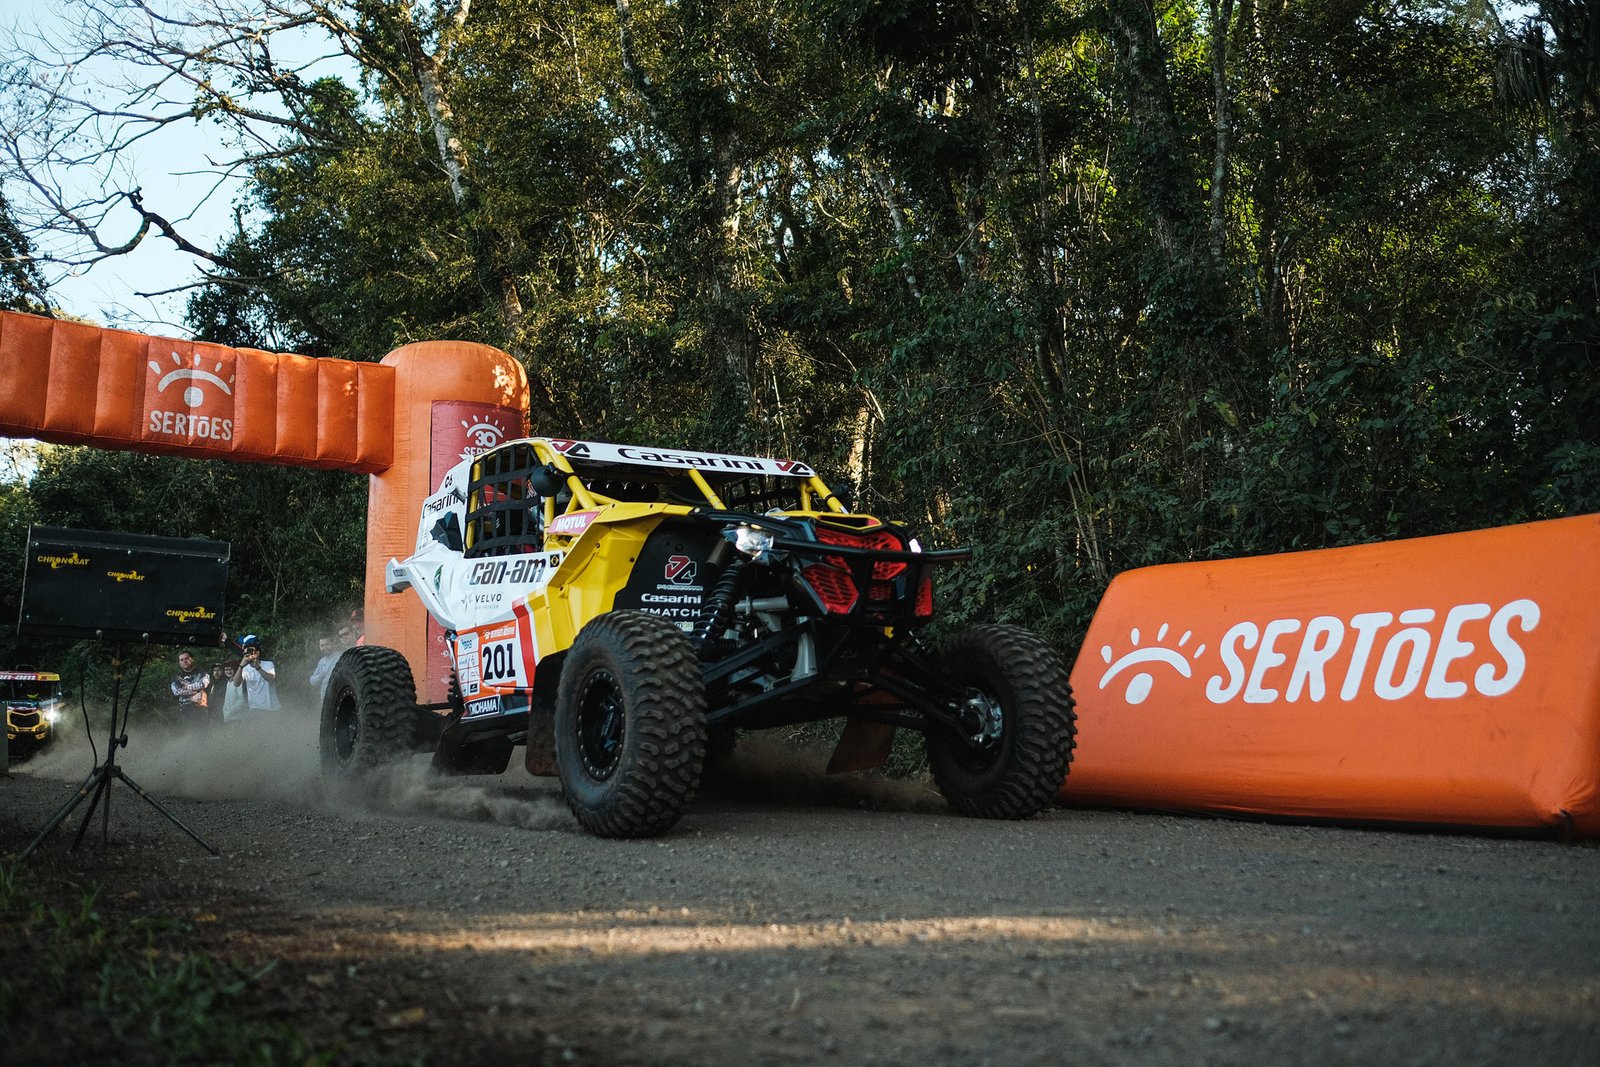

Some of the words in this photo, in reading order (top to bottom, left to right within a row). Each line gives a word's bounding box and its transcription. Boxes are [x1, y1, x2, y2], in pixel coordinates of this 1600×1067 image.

[474, 431, 497, 447] 30
[617, 447, 765, 471] Casarini
[555, 514, 587, 532] MOTUL
[37, 553, 90, 568] CHRONOSAT
[107, 571, 145, 581] CHRONOSAT
[475, 594, 502, 603] VELVO
[641, 593, 701, 604] Casarini
[166, 607, 216, 622] CHRONOSAT
[483, 643, 516, 680] 201
